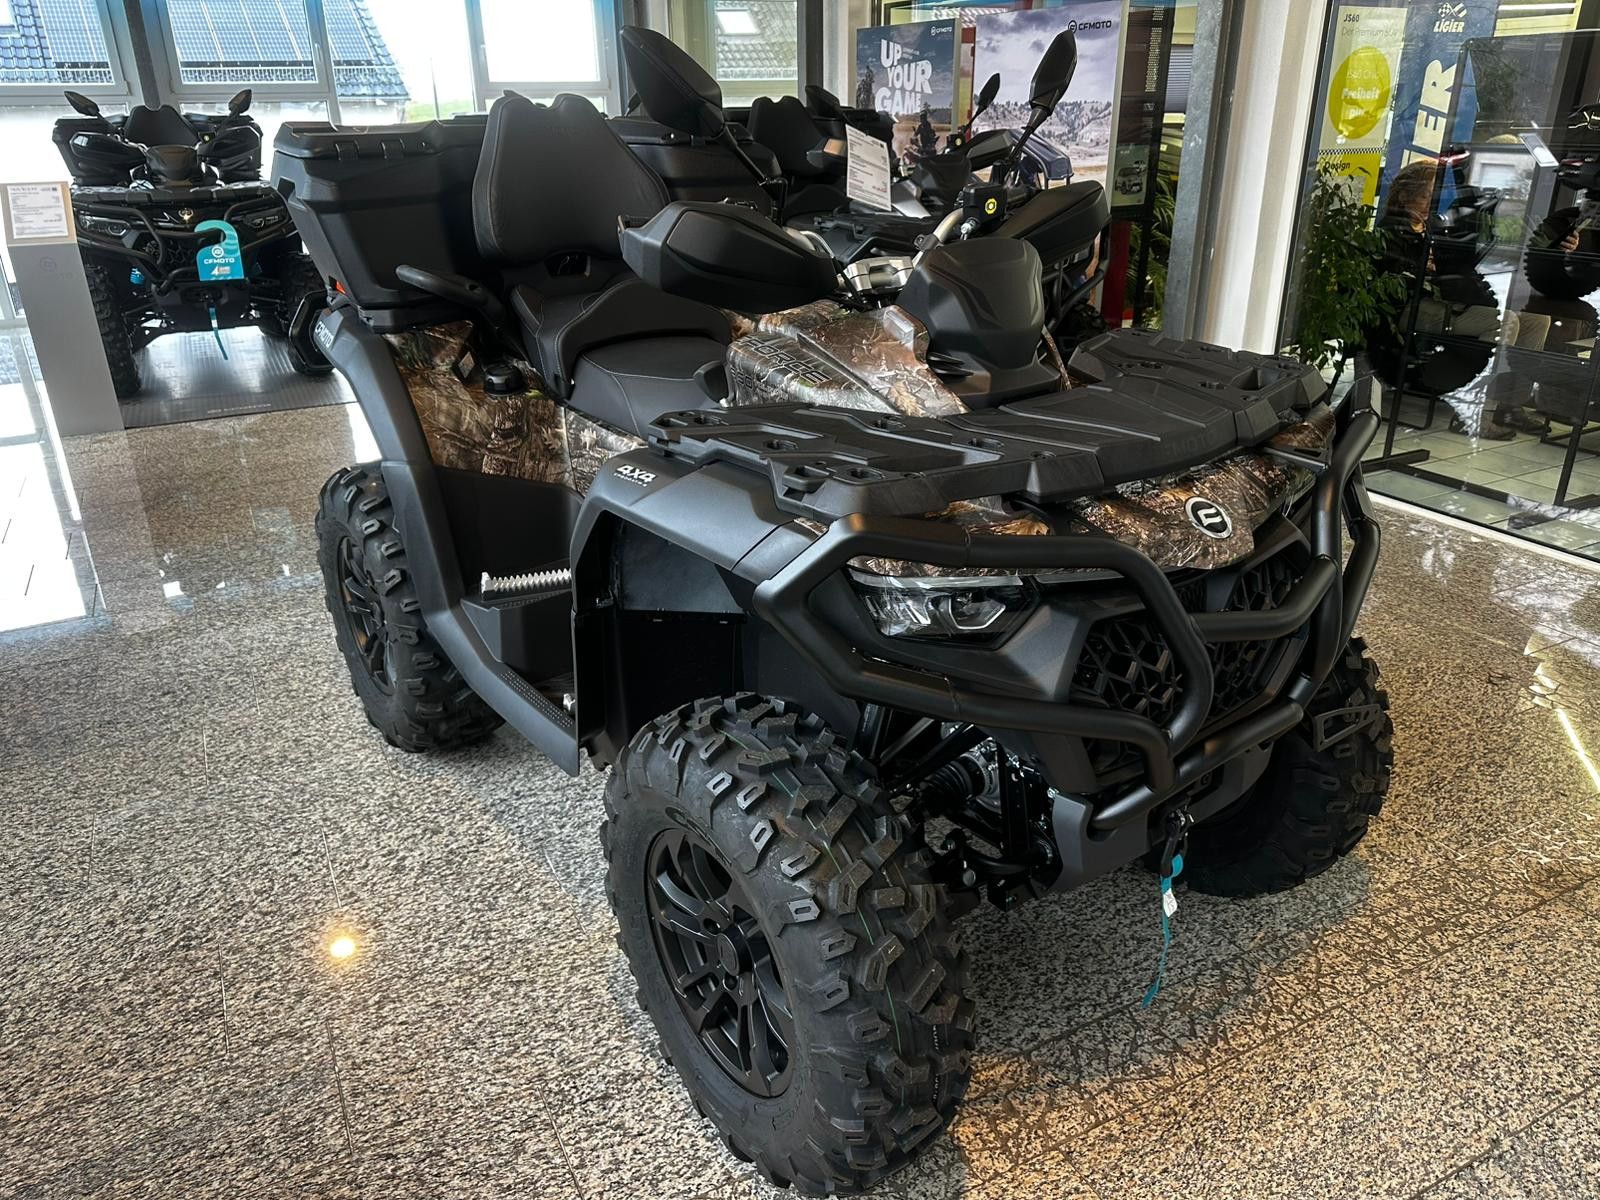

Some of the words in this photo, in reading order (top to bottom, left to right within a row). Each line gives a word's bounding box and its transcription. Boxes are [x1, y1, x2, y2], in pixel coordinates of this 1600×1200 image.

[1078, 20, 1112, 31] CFMOTO
[1344, 13, 1360, 22] JS60
[881, 39, 902, 68] UP
[887, 60, 933, 94] YOUR
[875, 87, 921, 115] GAME
[203, 257, 236, 265] CFMOTO
